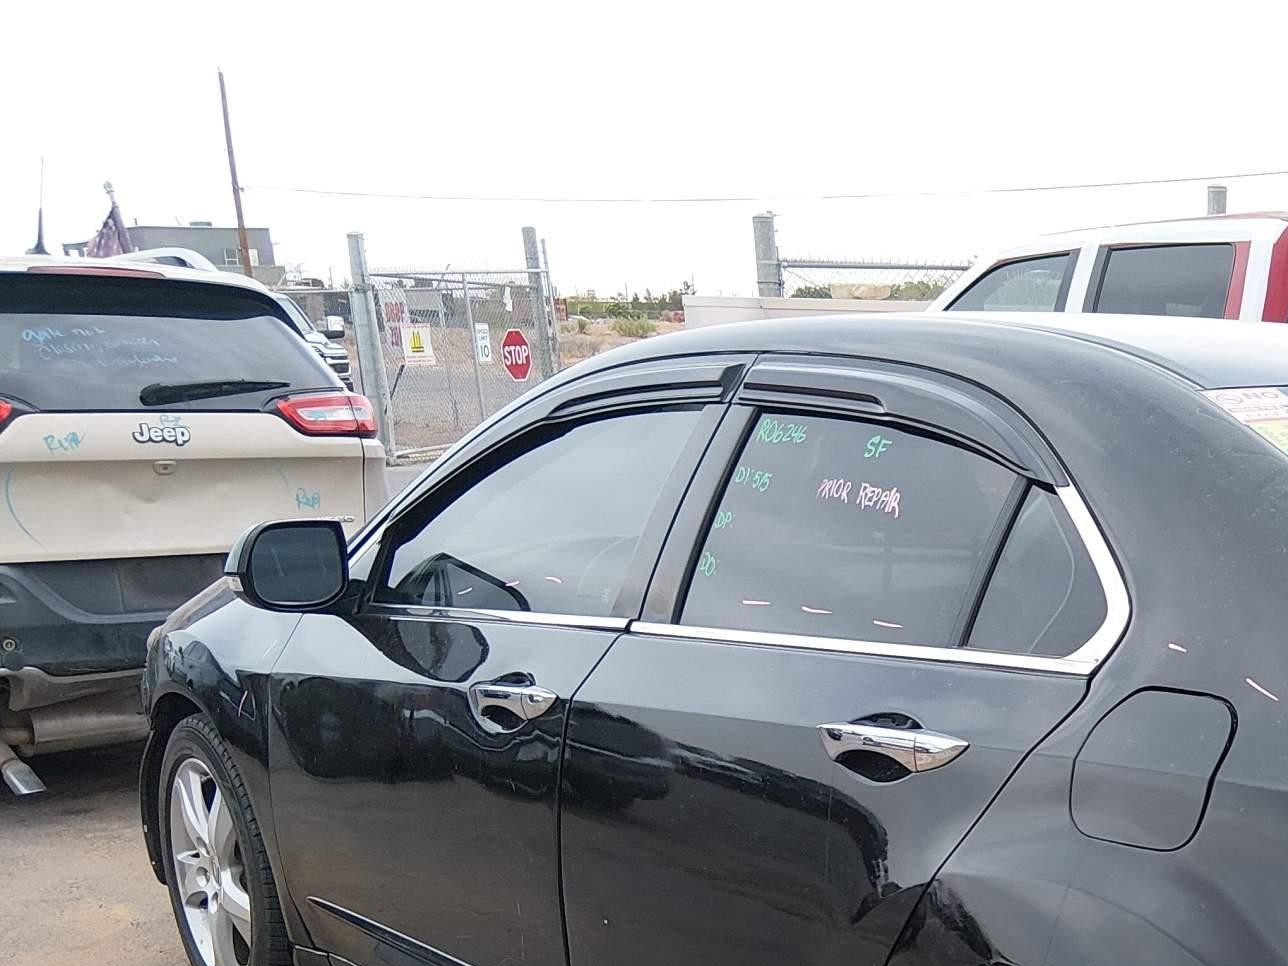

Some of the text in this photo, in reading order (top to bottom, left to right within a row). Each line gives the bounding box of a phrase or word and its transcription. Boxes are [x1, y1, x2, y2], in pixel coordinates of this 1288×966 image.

[480, 344, 490, 358] 10
[503, 345, 529, 366] STOP
[132, 422, 191, 447] Jeep
[863, 435, 893, 458] SF
[816, 478, 901, 519] PRIOR REPAIR
